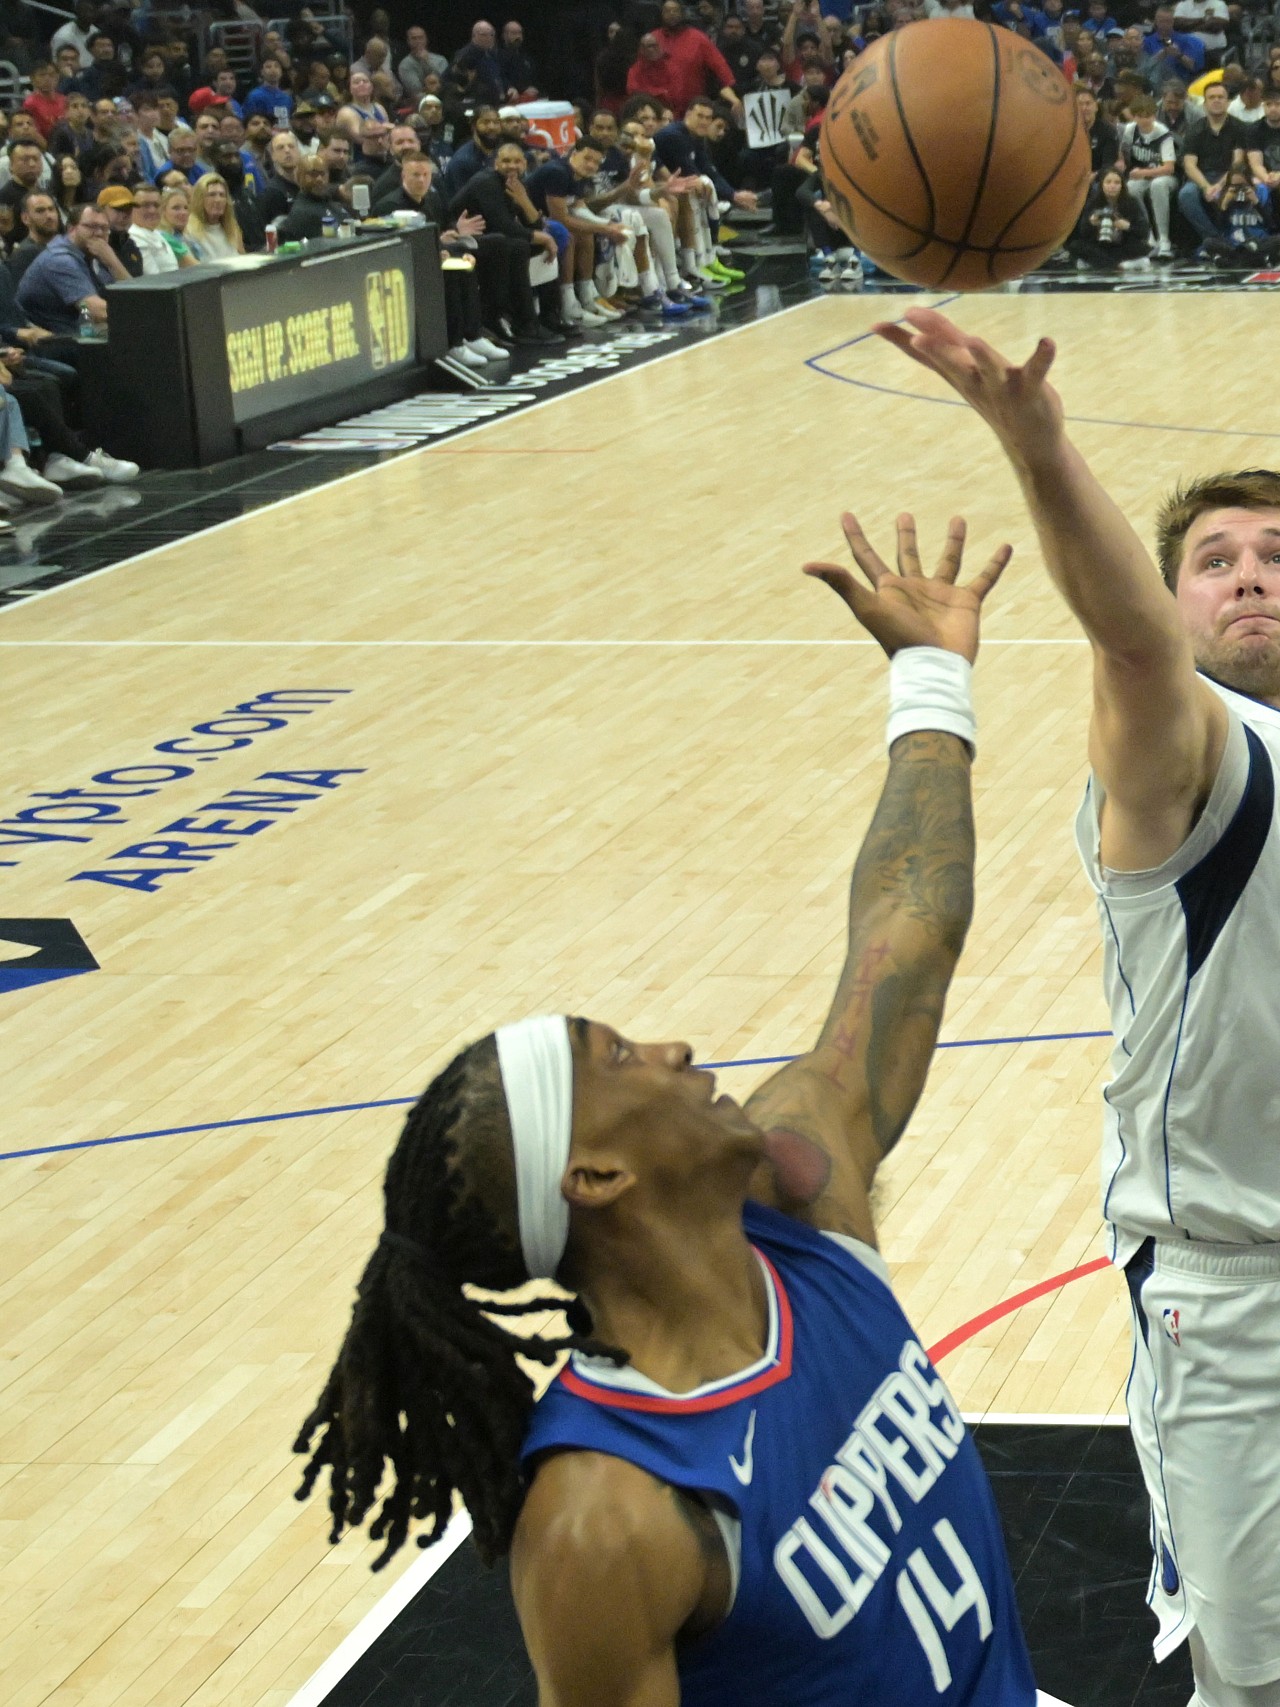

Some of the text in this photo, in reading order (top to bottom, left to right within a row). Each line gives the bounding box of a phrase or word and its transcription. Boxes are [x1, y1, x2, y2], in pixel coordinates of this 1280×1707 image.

[226, 327, 264, 392] SIGN
[286, 308, 333, 375] SCORE
[0, 689, 354, 867] ypto.com
[64, 768, 370, 893] ARENA
[773, 1339, 966, 1640] CLIPPERS
[896, 1518, 993, 1693] 14
